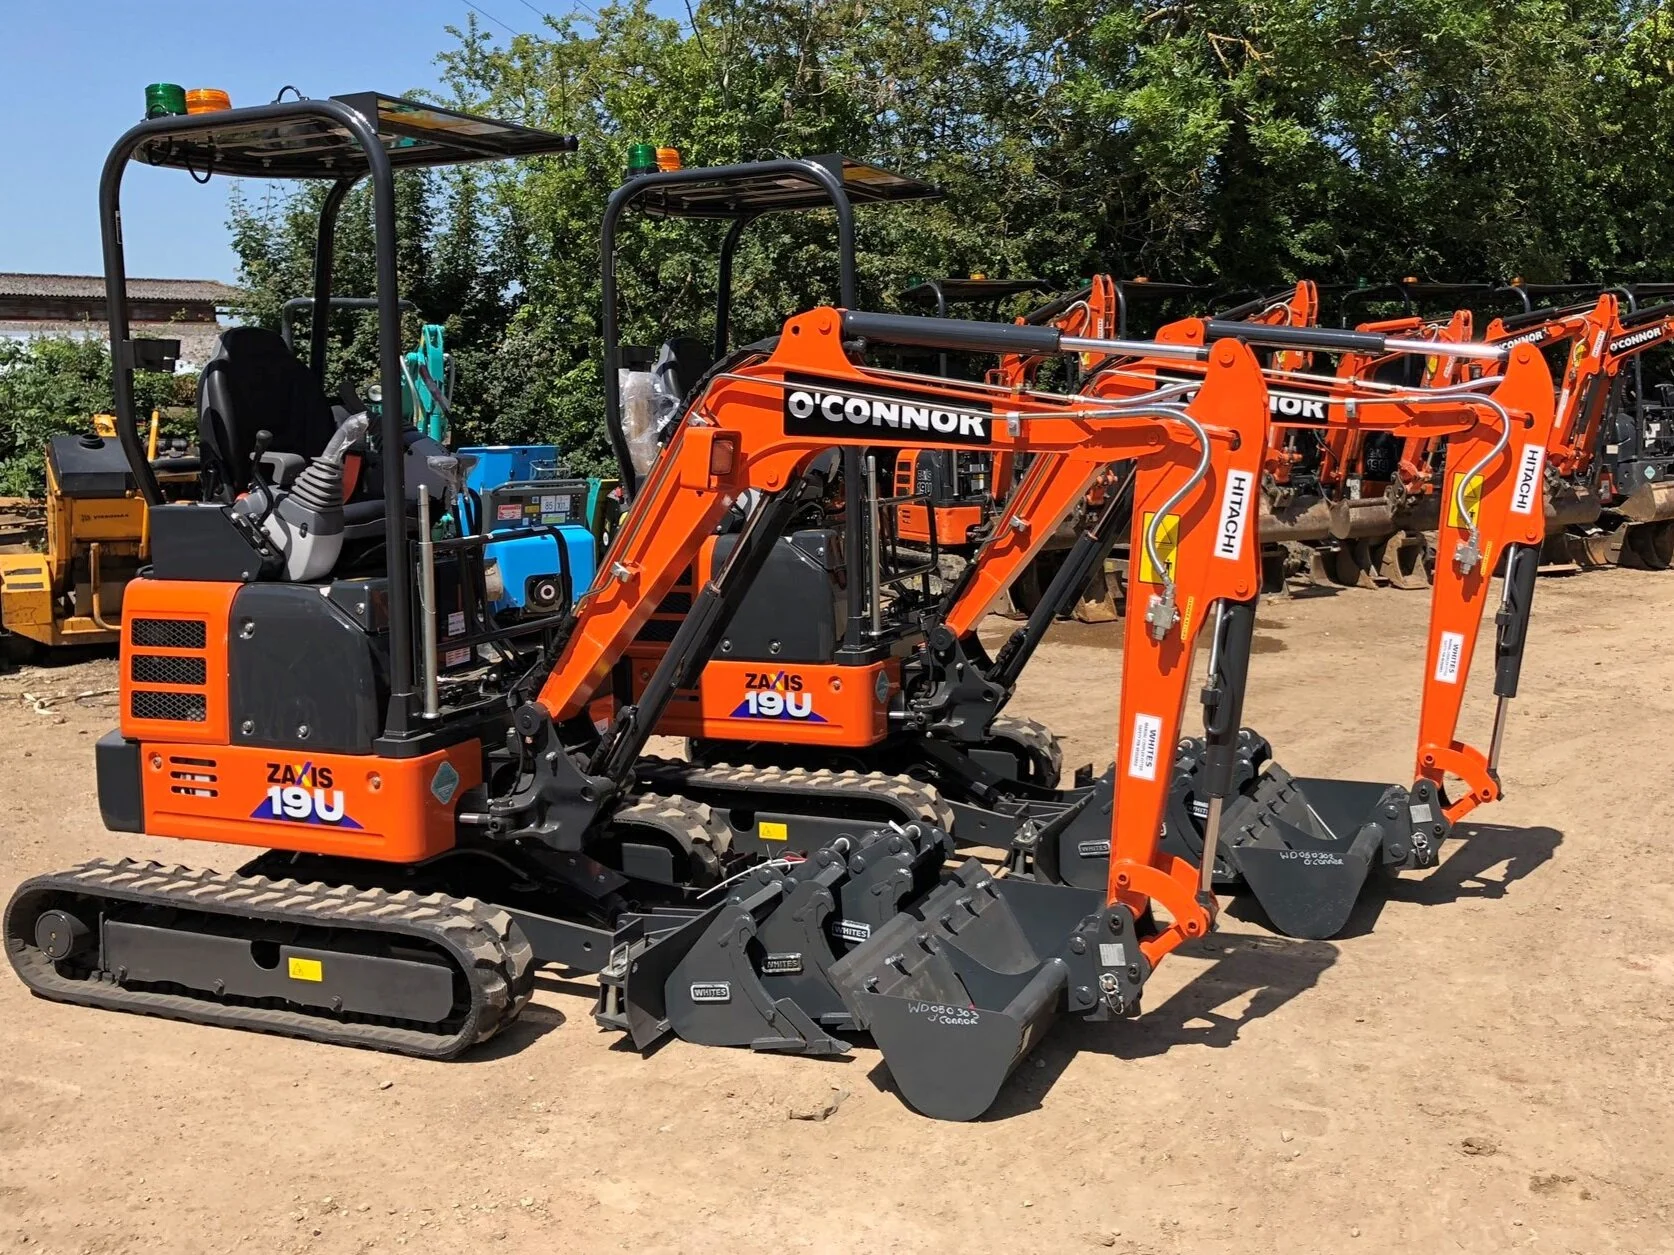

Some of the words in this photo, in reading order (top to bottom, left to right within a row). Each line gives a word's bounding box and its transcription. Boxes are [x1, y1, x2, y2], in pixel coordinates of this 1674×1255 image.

[1610, 327, 1662, 352] O'CONNOR
[788, 391, 985, 437] O'CONNOR
[1516, 449, 1539, 510] HITACHI
[1221, 476, 1247, 554] HITACHI
[1448, 644, 1459, 674] WHITES
[745, 670, 803, 692] ZAXIS
[744, 691, 812, 718] 19U
[1145, 729, 1157, 768] WHITES
[266, 761, 334, 788] ZAXIS
[266, 785, 344, 822] 19U
[1080, 845, 1109, 853] WHITES
[833, 924, 868, 938] WHITES
[693, 987, 727, 998] WHITES
